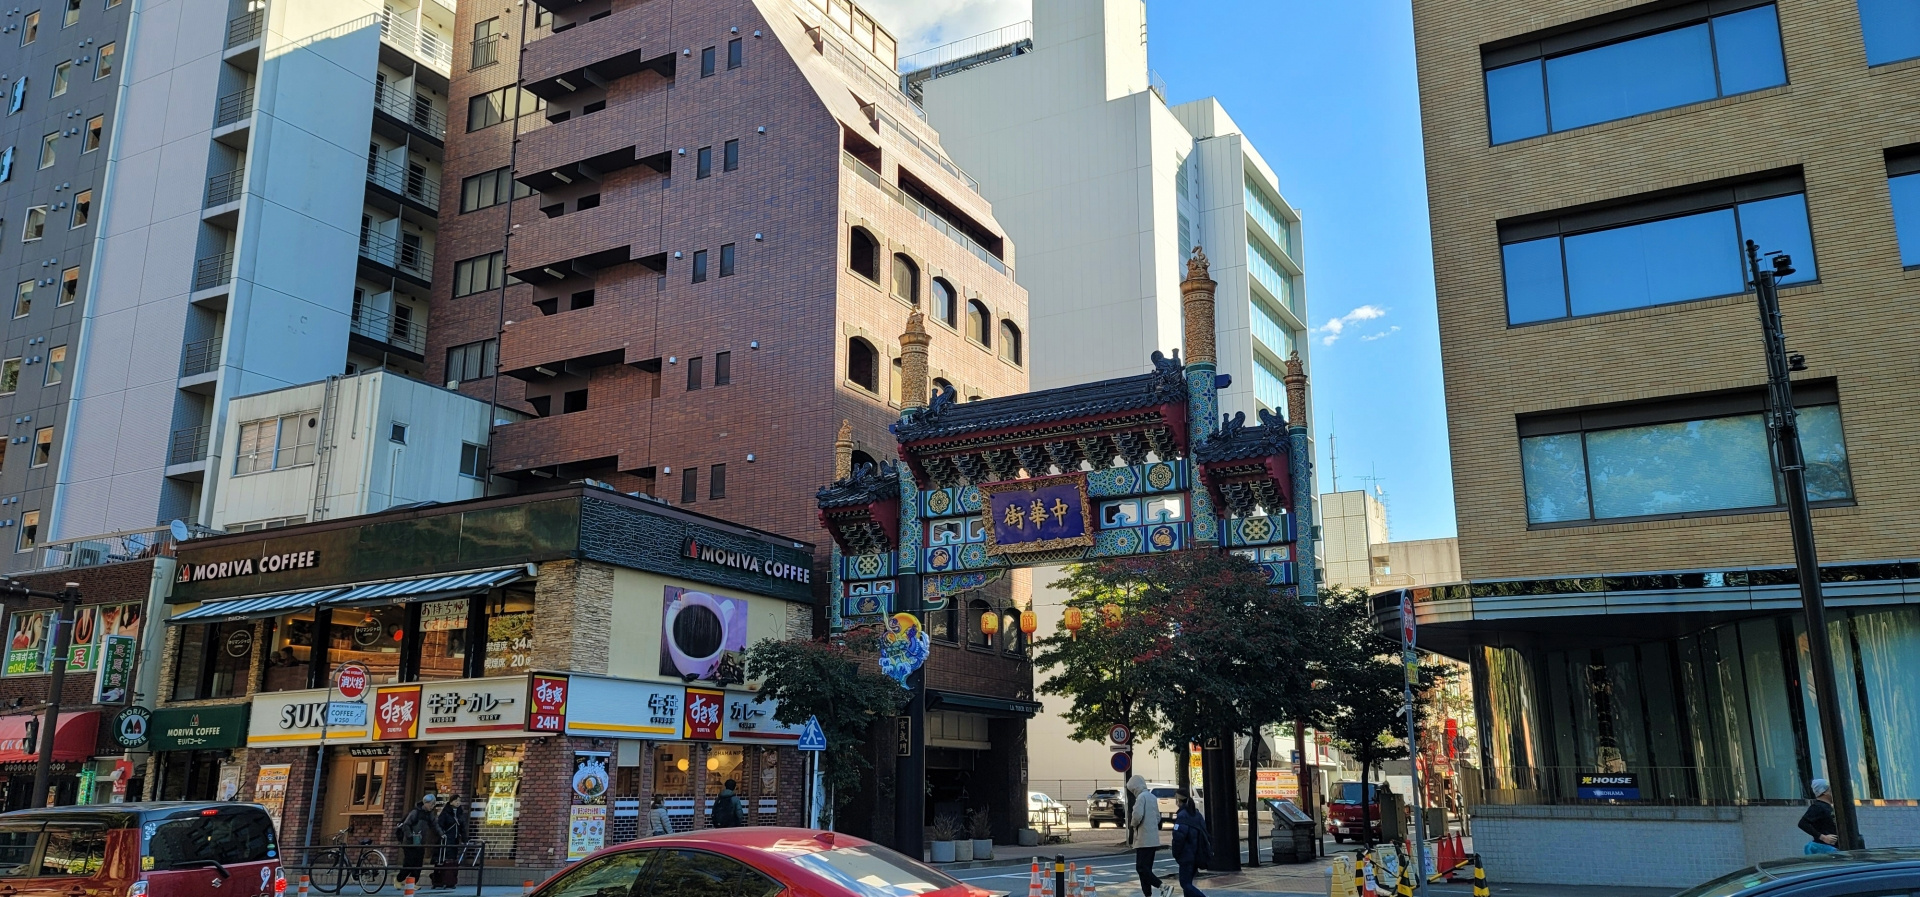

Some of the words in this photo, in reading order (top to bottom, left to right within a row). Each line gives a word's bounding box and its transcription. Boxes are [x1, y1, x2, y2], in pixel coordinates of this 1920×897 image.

[1003, 498, 1068, 530] 中華街
[193, 558, 253, 581] MORIVA
[259, 550, 315, 573] COFFEE
[701, 545, 759, 573] MORIVA
[764, 559, 810, 584] COFFEE
[341, 676, 364, 689] 消火栓
[536, 680, 563, 705] すき家
[120, 708, 150, 721] MORIVA
[380, 694, 414, 725] すき家
[649, 693, 678, 715] 牛丼
[690, 694, 719, 726] すき家
[732, 702, 766, 720] カレー
[279, 702, 327, 729] SUK
[537, 715, 558, 729] 24H
[119, 735, 147, 746] COFFEE
[196, 727, 220, 735] COFFEE
[1112, 730, 1125, 739] 30
